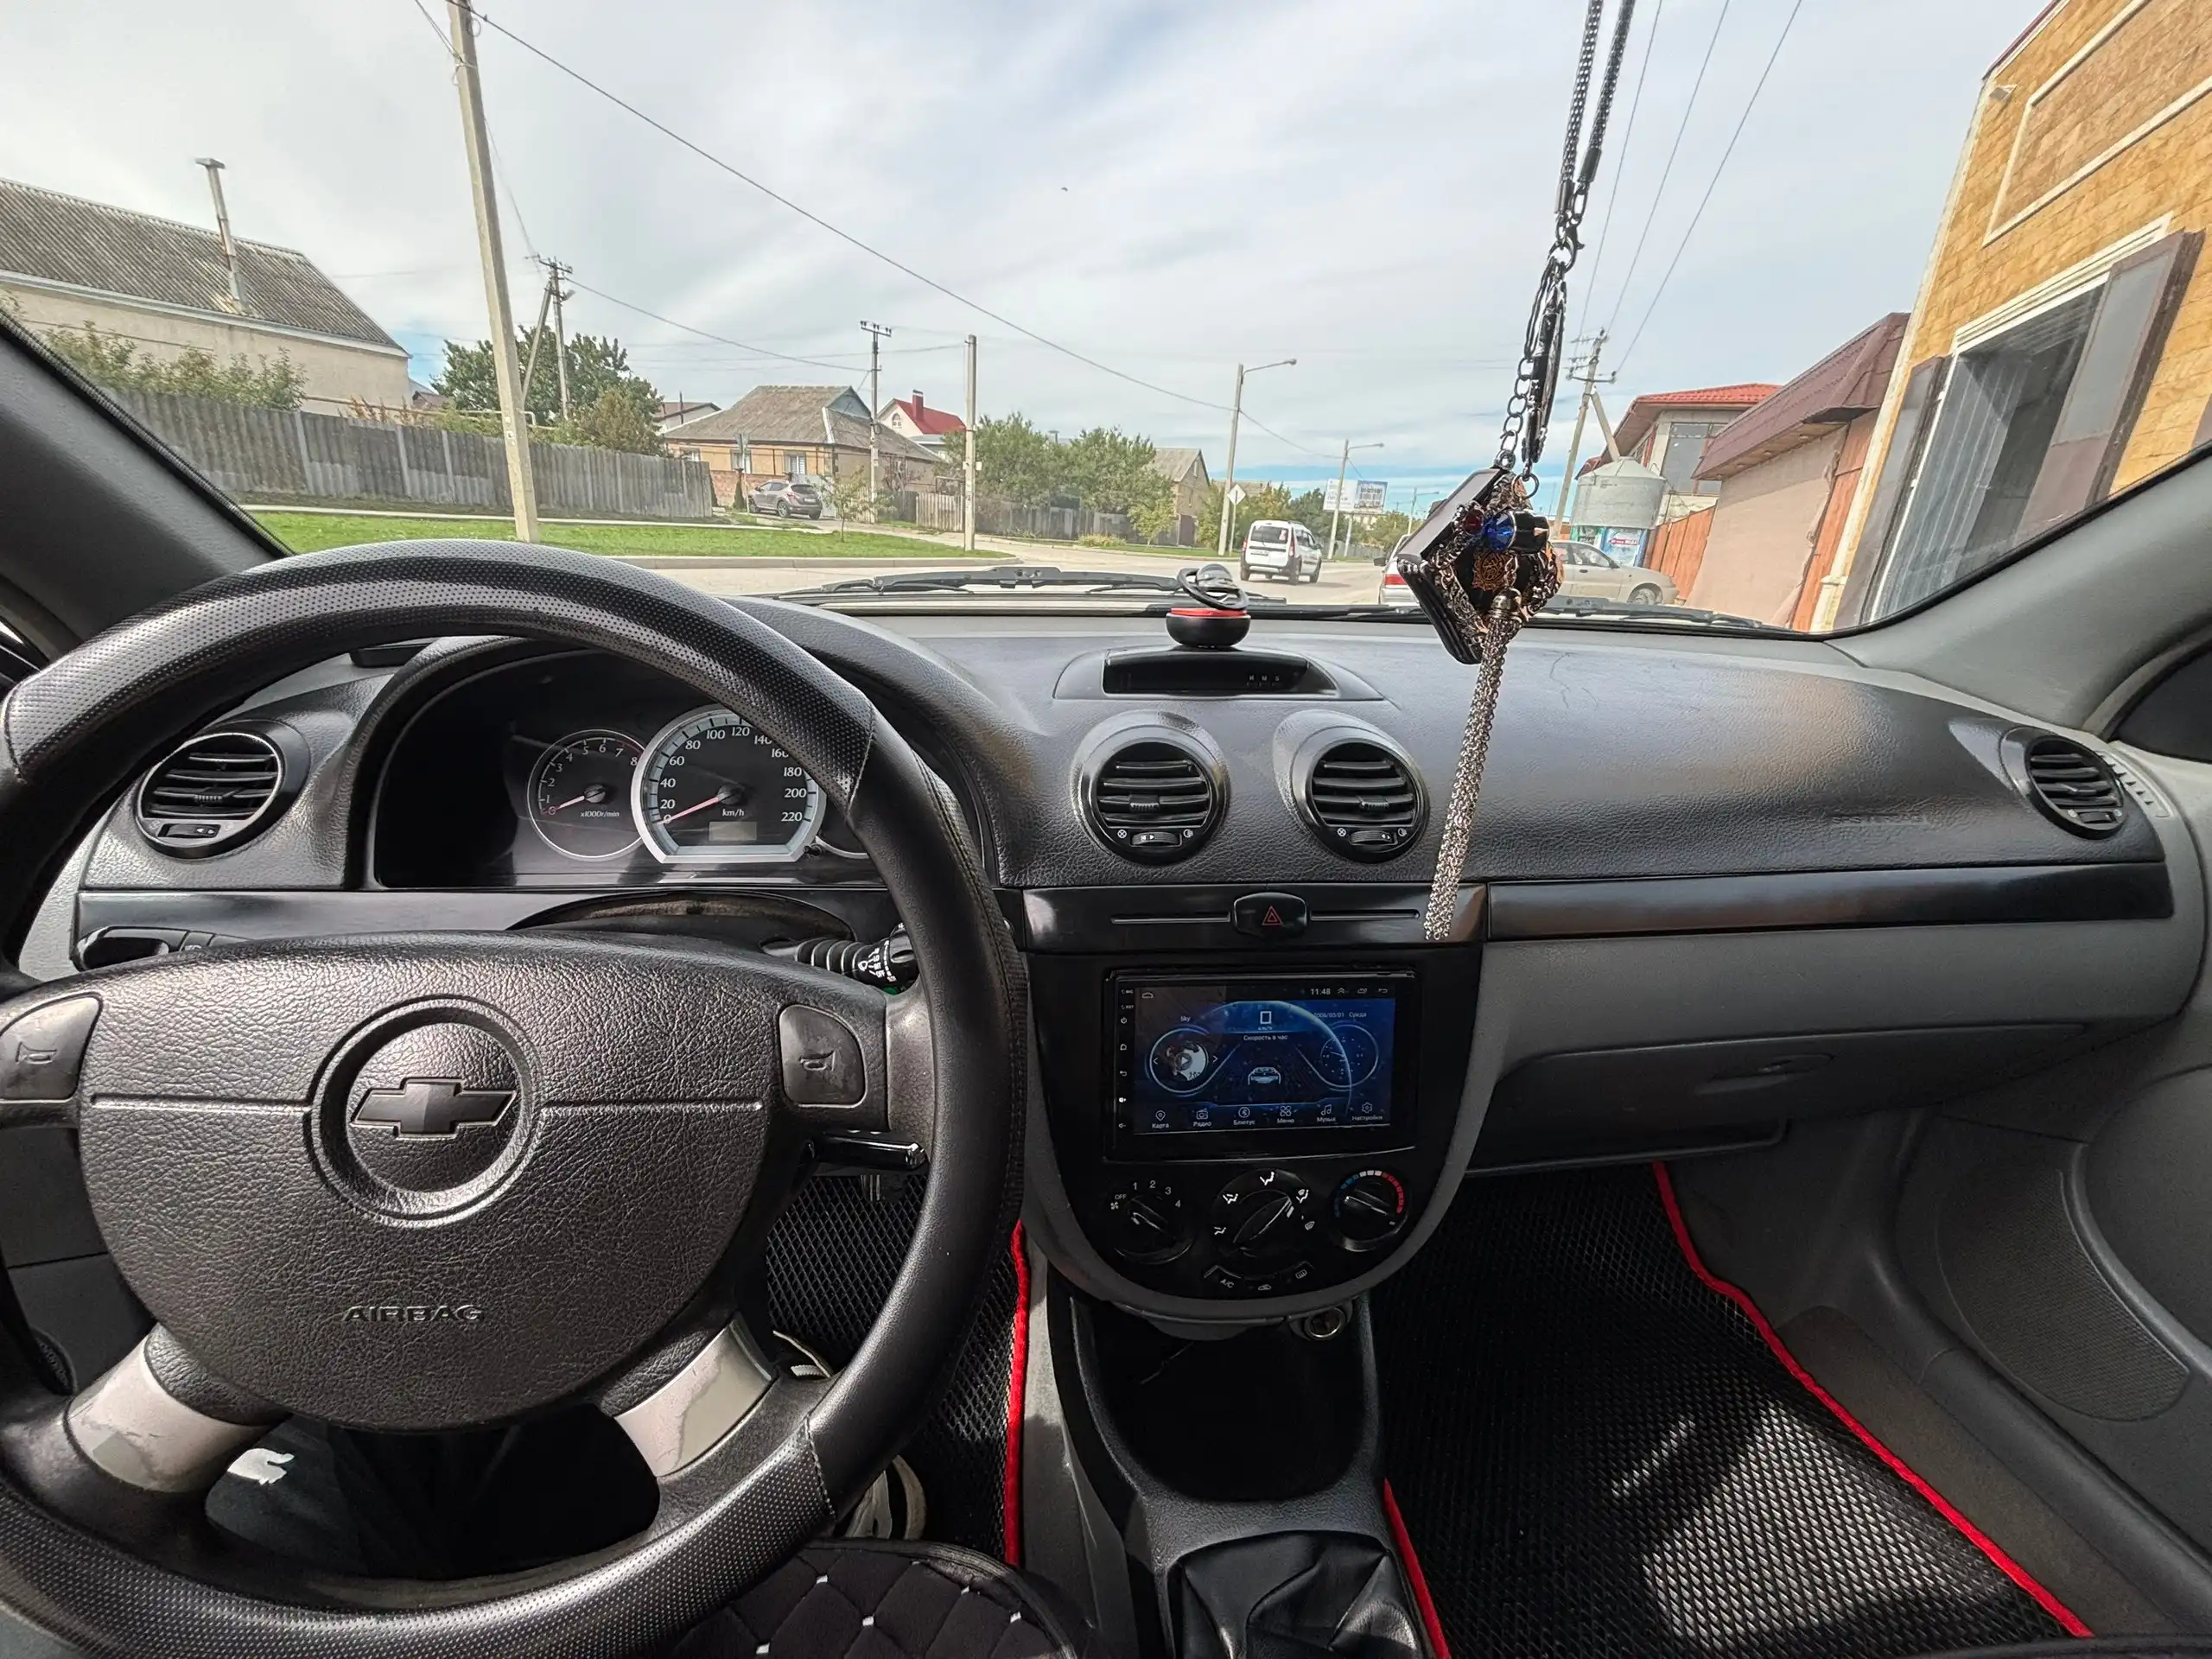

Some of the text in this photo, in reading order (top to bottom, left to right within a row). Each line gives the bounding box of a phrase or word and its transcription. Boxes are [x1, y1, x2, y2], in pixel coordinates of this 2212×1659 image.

[706, 729, 726, 740] 100
[731, 727, 750, 736] 120
[599, 744, 606, 753] 6
[685, 740, 701, 750] 80
[582, 746, 589, 755] 5
[615, 747, 624, 757] 7
[565, 753, 573, 762] 4
[630, 756, 638, 766] 8
[669, 755, 685, 766] 60
[555, 763, 563, 772] 3
[783, 767, 802, 777] 180
[547, 778, 555, 787] 2
[659, 778, 677, 788] 40
[784, 788, 807, 798] 200
[546, 794, 550, 804] 1
[659, 799, 676, 809] 20
[721, 809, 745, 817] km/h
[780, 811, 803, 822] 220
[1133, 1181, 1138, 1191] 1
[1148, 1179, 1156, 1189] 2
[1164, 1186, 1172, 1196] 3
[1174, 1198, 1181, 1208] 4
[1219, 1278, 1235, 1288] A/C
[340, 1304, 484, 1323] AIRBAG
